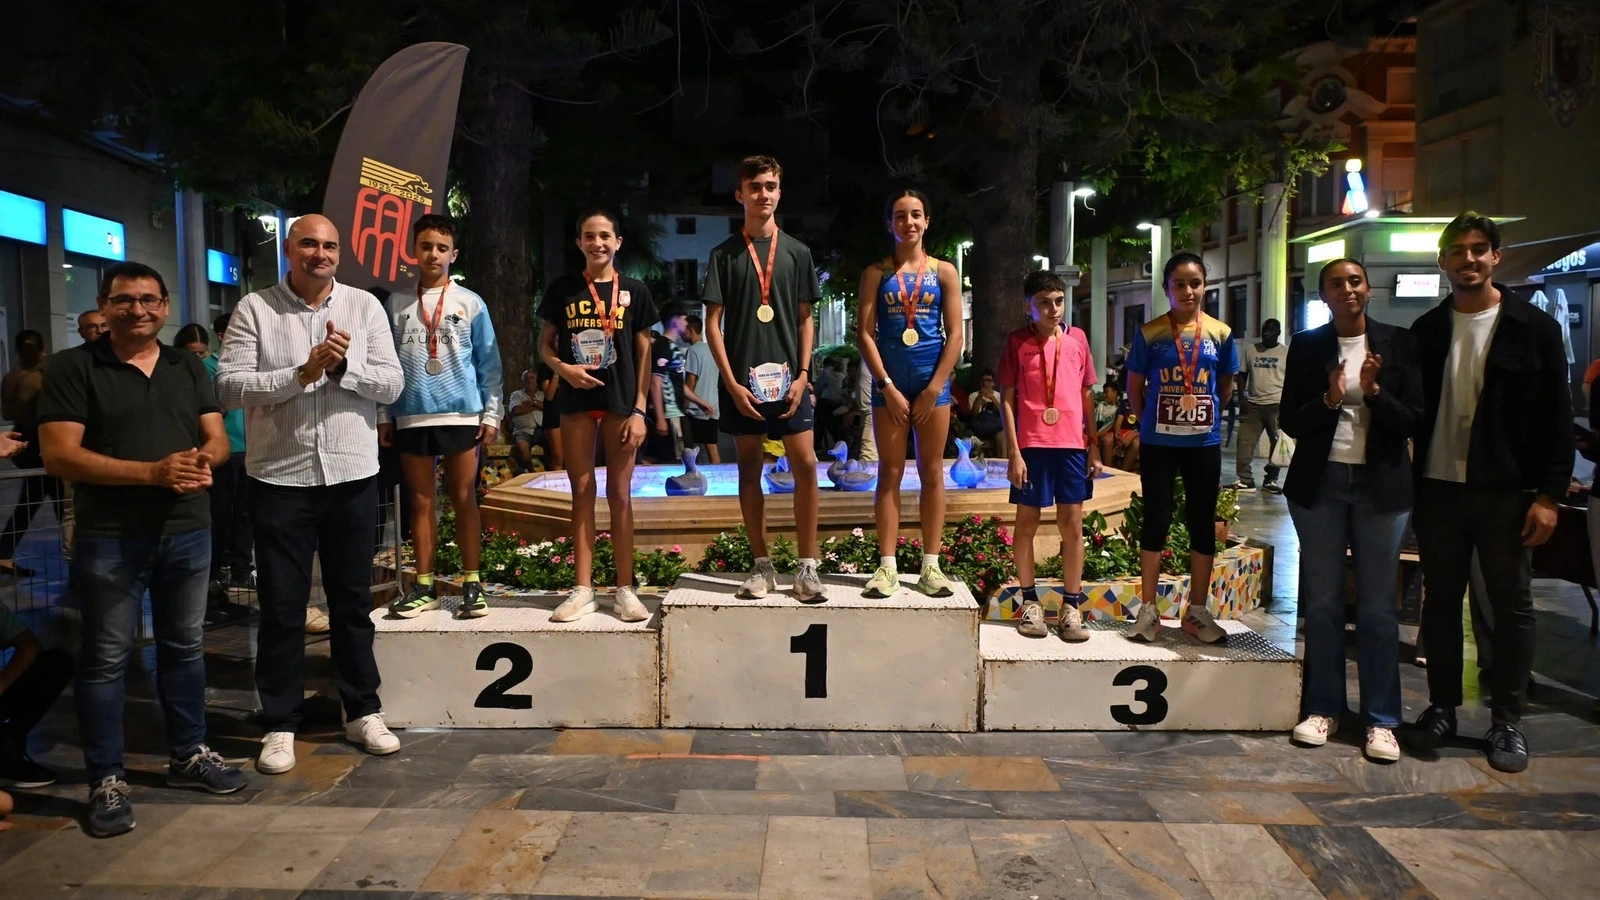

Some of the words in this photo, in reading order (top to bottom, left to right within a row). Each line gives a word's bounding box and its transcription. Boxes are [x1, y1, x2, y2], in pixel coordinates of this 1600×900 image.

[1159, 365, 1211, 385] UCM
[1165, 405, 1208, 422] 1205
[474, 642, 534, 709] 2
[790, 623, 827, 699] 1
[1110, 664, 1169, 725] 3
